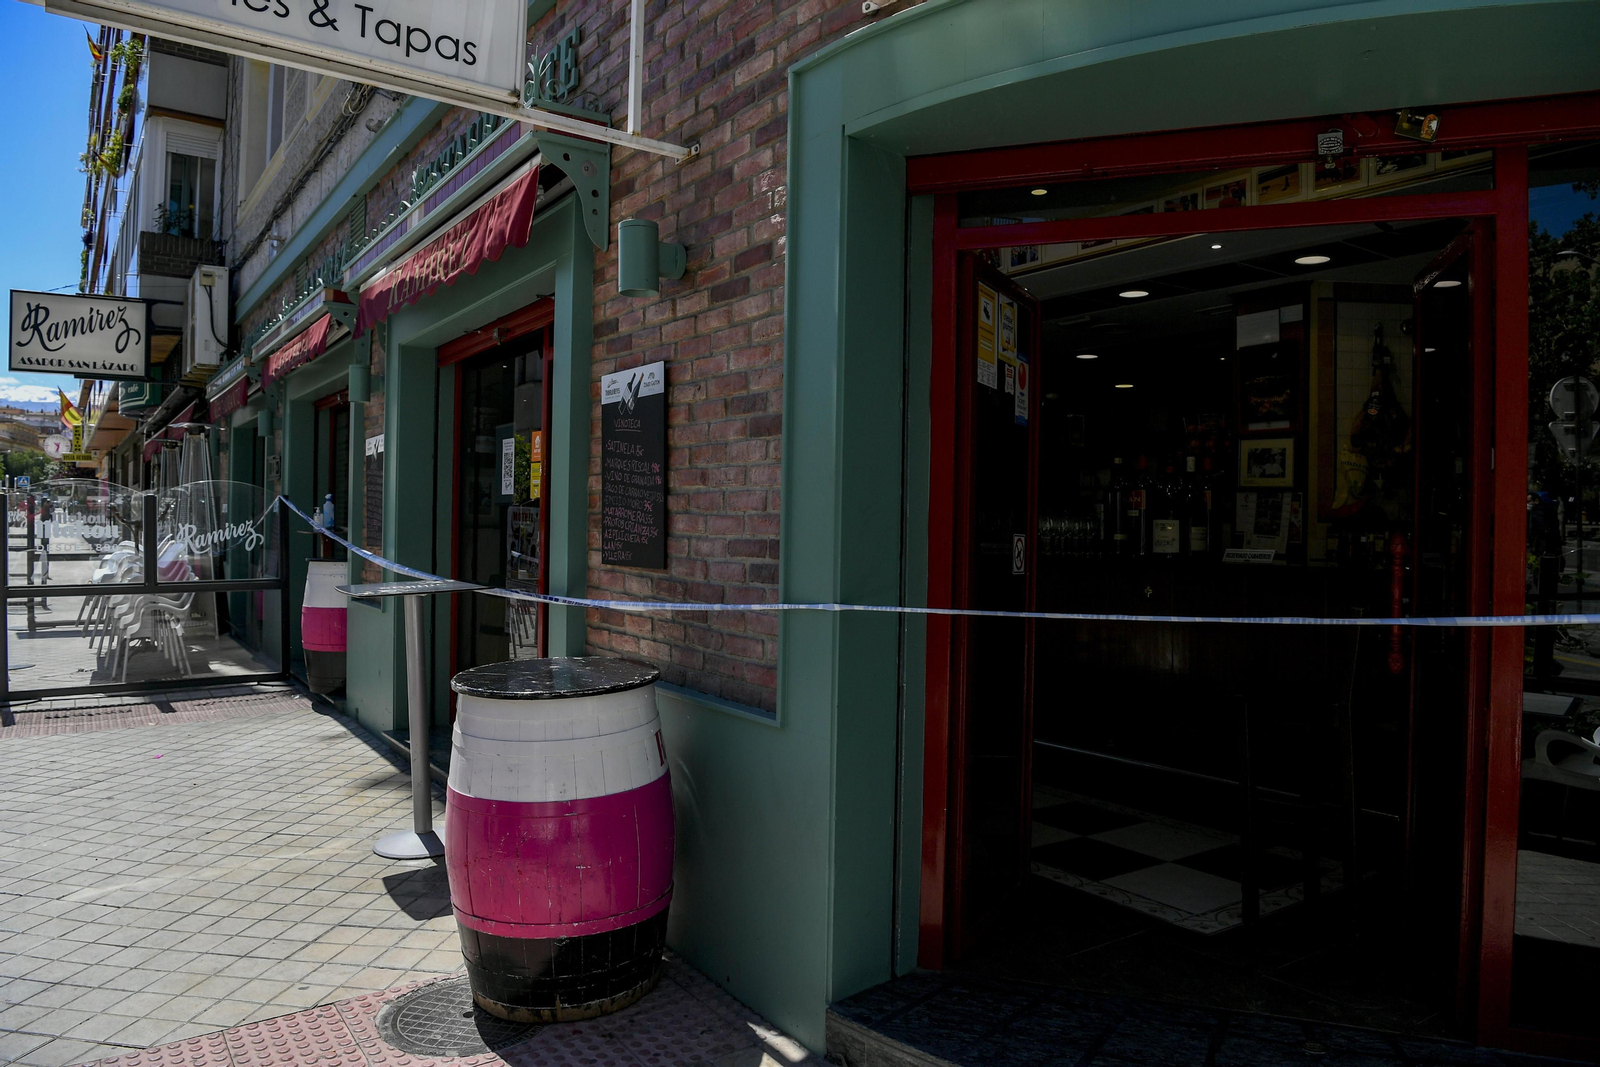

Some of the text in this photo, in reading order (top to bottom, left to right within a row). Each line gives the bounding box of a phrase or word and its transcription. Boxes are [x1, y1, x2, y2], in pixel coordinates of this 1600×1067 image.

[308, 0, 339, 31] &
[354, 4, 477, 65] Tapas
[18, 356, 66, 368] ASADOR
[68, 359, 91, 369] SAN
[613, 418, 641, 428] VINOTECA
[605, 470, 622, 481] VINO
[623, 472, 631, 483] DE
[36, 519, 120, 539] Mahou
[36, 543, 81, 552] DESDE
